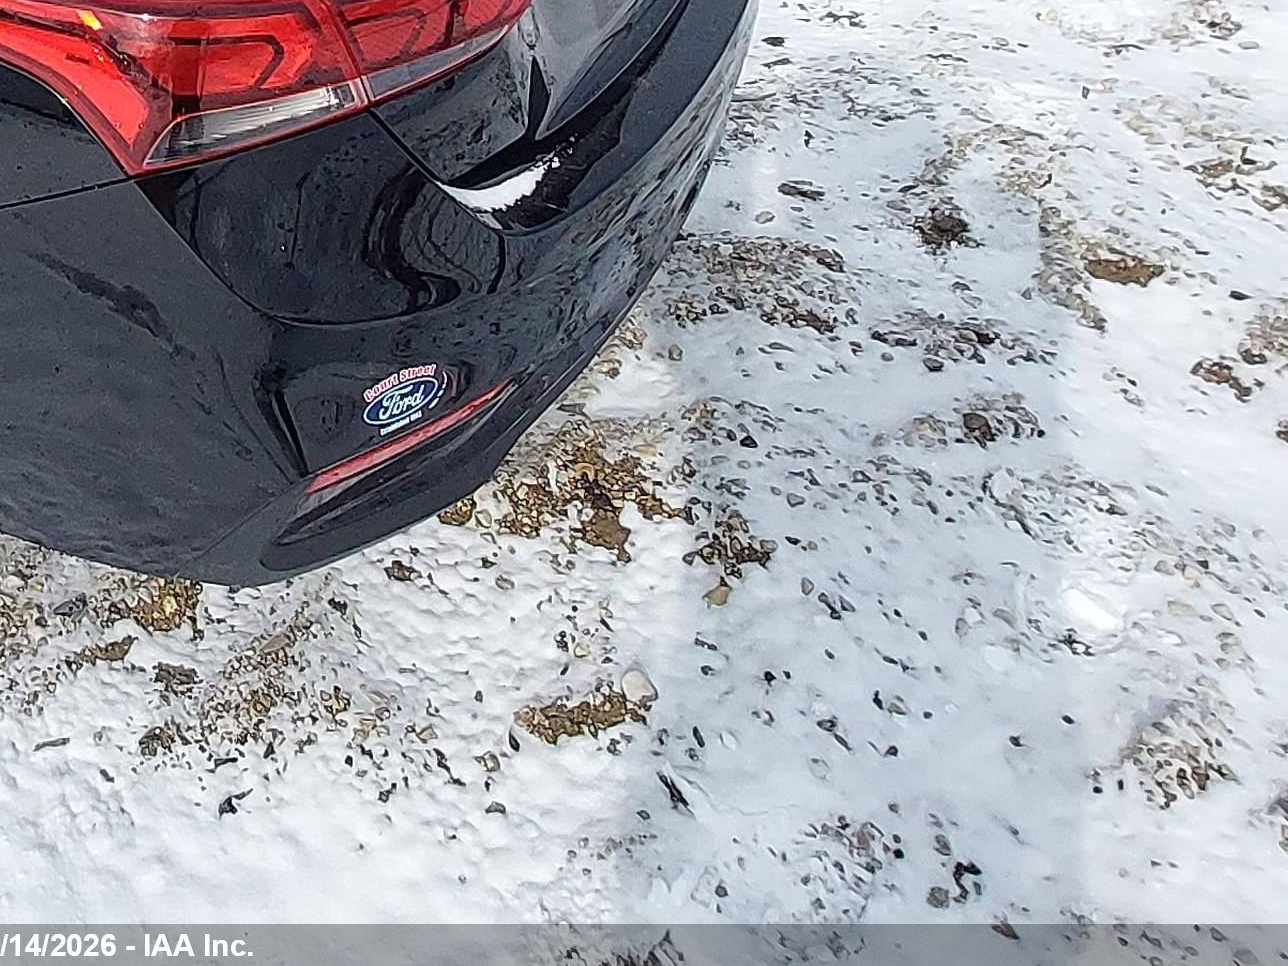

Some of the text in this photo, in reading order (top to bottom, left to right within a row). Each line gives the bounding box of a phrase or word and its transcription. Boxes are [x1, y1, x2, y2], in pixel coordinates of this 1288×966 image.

[362, 363, 437, 402] Court Street
[378, 384, 425, 420] Ford
